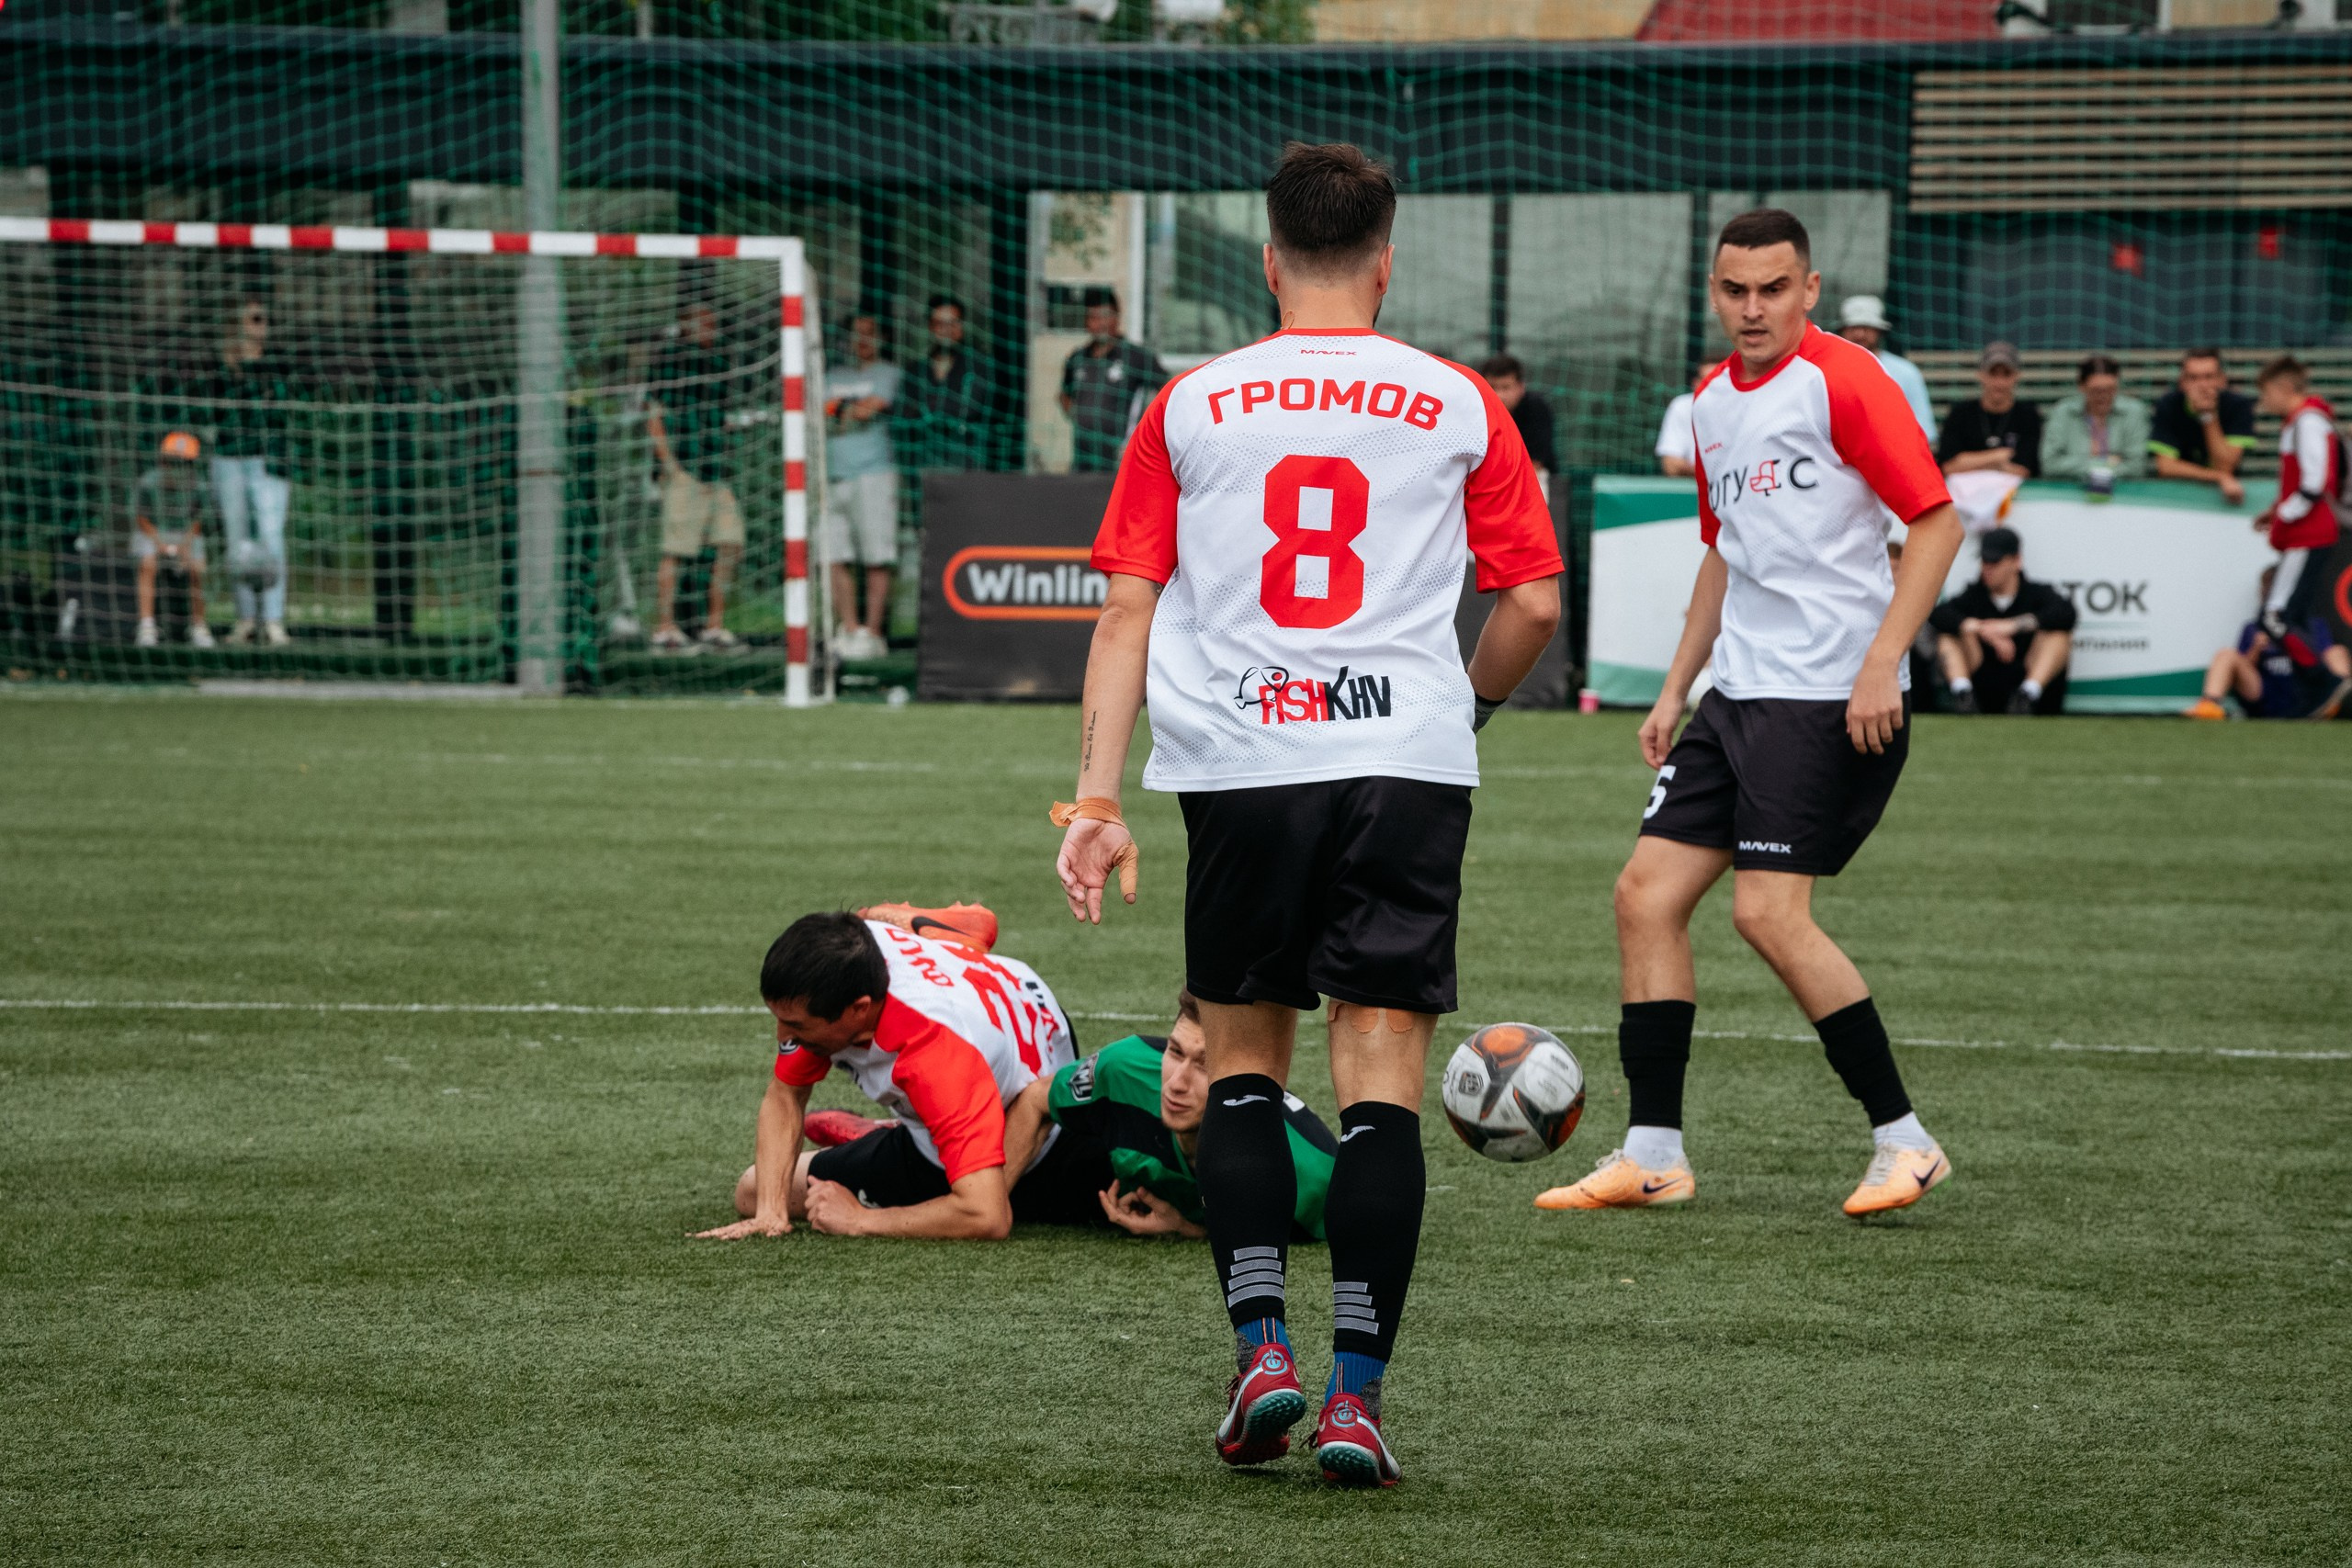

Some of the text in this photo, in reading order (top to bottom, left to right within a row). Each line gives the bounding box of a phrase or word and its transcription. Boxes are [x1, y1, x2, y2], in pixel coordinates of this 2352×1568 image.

[1206, 378, 1444, 432] ГРОМОВ
[1260, 454, 1370, 629] 8
[967, 562, 1110, 604] Winlin
[2062, 580, 2148, 614] ТОК
[1738, 840, 1792, 853] MAVEX
